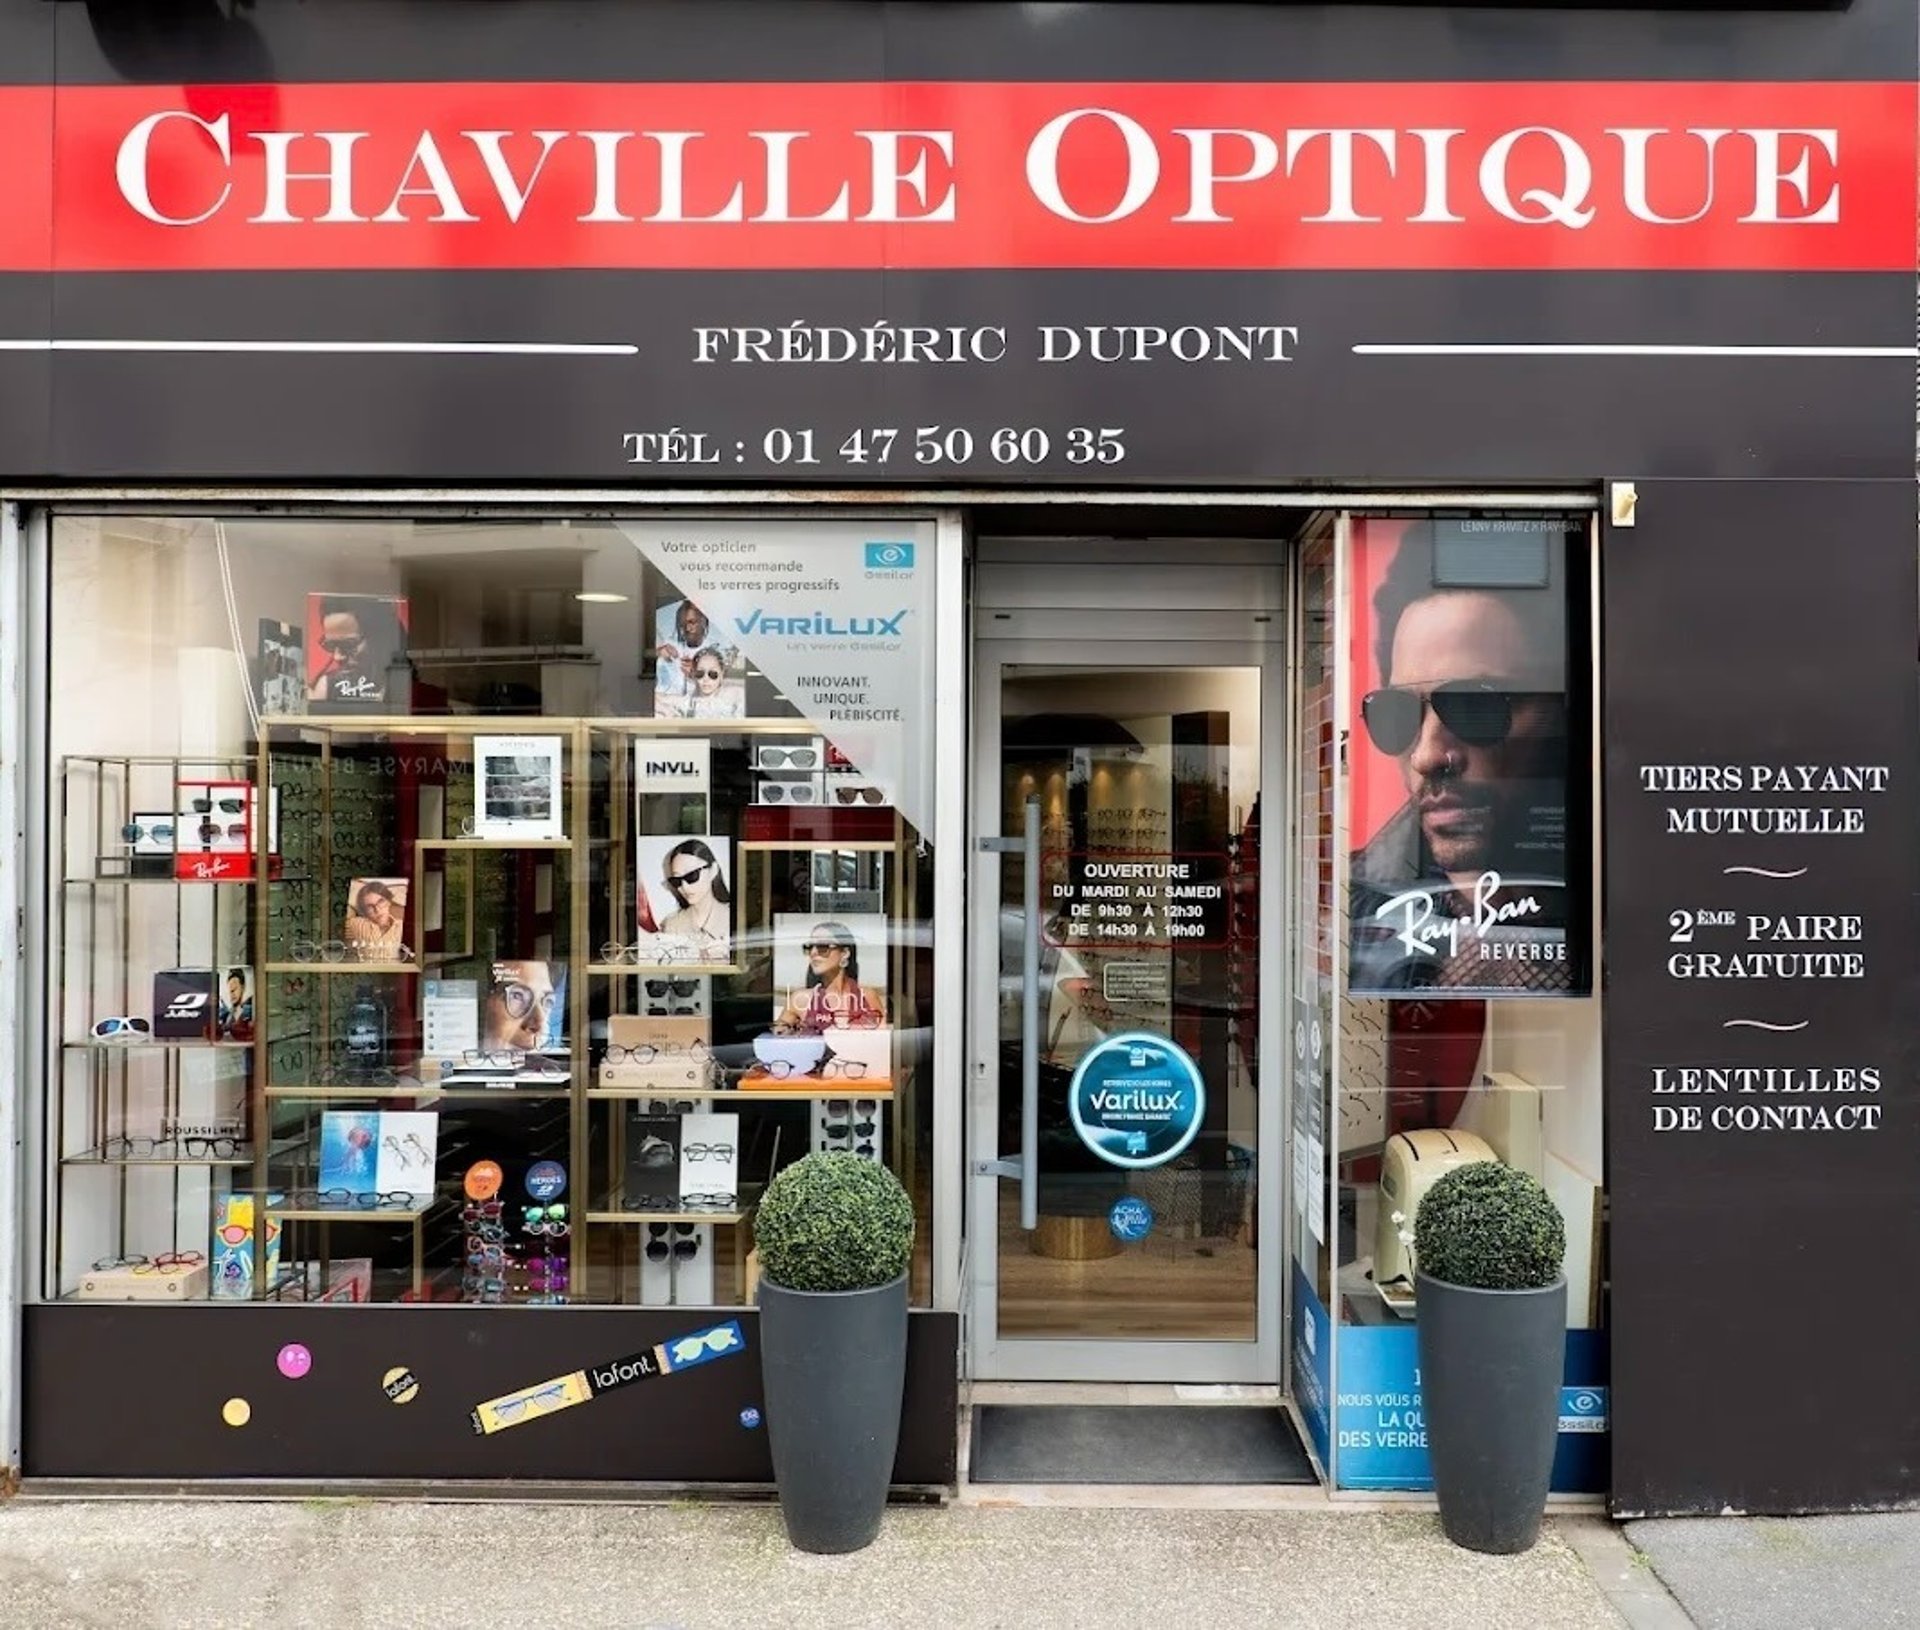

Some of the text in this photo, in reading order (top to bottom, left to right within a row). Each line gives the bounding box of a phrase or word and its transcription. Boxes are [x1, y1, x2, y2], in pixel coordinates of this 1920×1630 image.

[693, 321, 1299, 363] FRÉDÉRIC DUPONT
[624, 428, 720, 464] TÉL
[763, 428, 818, 464] 01
[838, 428, 898, 464] 47
[914, 428, 974, 464] 50
[990, 428, 1050, 464] 60
[1066, 428, 1125, 464] 35
[1461, 520, 1491, 533] LENNY
[661, 540, 756, 556] Votre opticien
[679, 560, 803, 573] vous recommande
[698, 578, 840, 594] les verres progressifs
[797, 676, 871, 689] INNOVANT.
[813, 692, 870, 706] UNIQUE.
[829, 705, 905, 722] PLÉBISCITÉ.
[646, 761, 699, 775] INVU.
[1640, 765, 1889, 792] TIERS PAYANT
[1666, 807, 1865, 834] MUTUELLE
[1084, 863, 1190, 879] OUVERTURE
[1053, 885, 1222, 899] DU MARDI AU SAMEDI
[1071, 902, 1203, 917] DE 9h30 À 12h30
[1069, 921, 1205, 937] DE 14h30 À 19h00
[1747, 916, 1862, 941] PAIRE
[1480, 943, 1567, 961] REVERSE
[1668, 953, 1865, 979] GRATUITE
[786, 983, 867, 1012] lafont
[1652, 1067, 1881, 1094] LENTILLES
[1652, 1105, 1881, 1131] DE CONTACT
[592, 1355, 656, 1390] lafont
[1338, 1394, 1372, 1406] NOUS
[1375, 1394, 1410, 1406] VOUS
[1379, 1411, 1400, 1427] LA
[1339, 1431, 1371, 1448] DES
